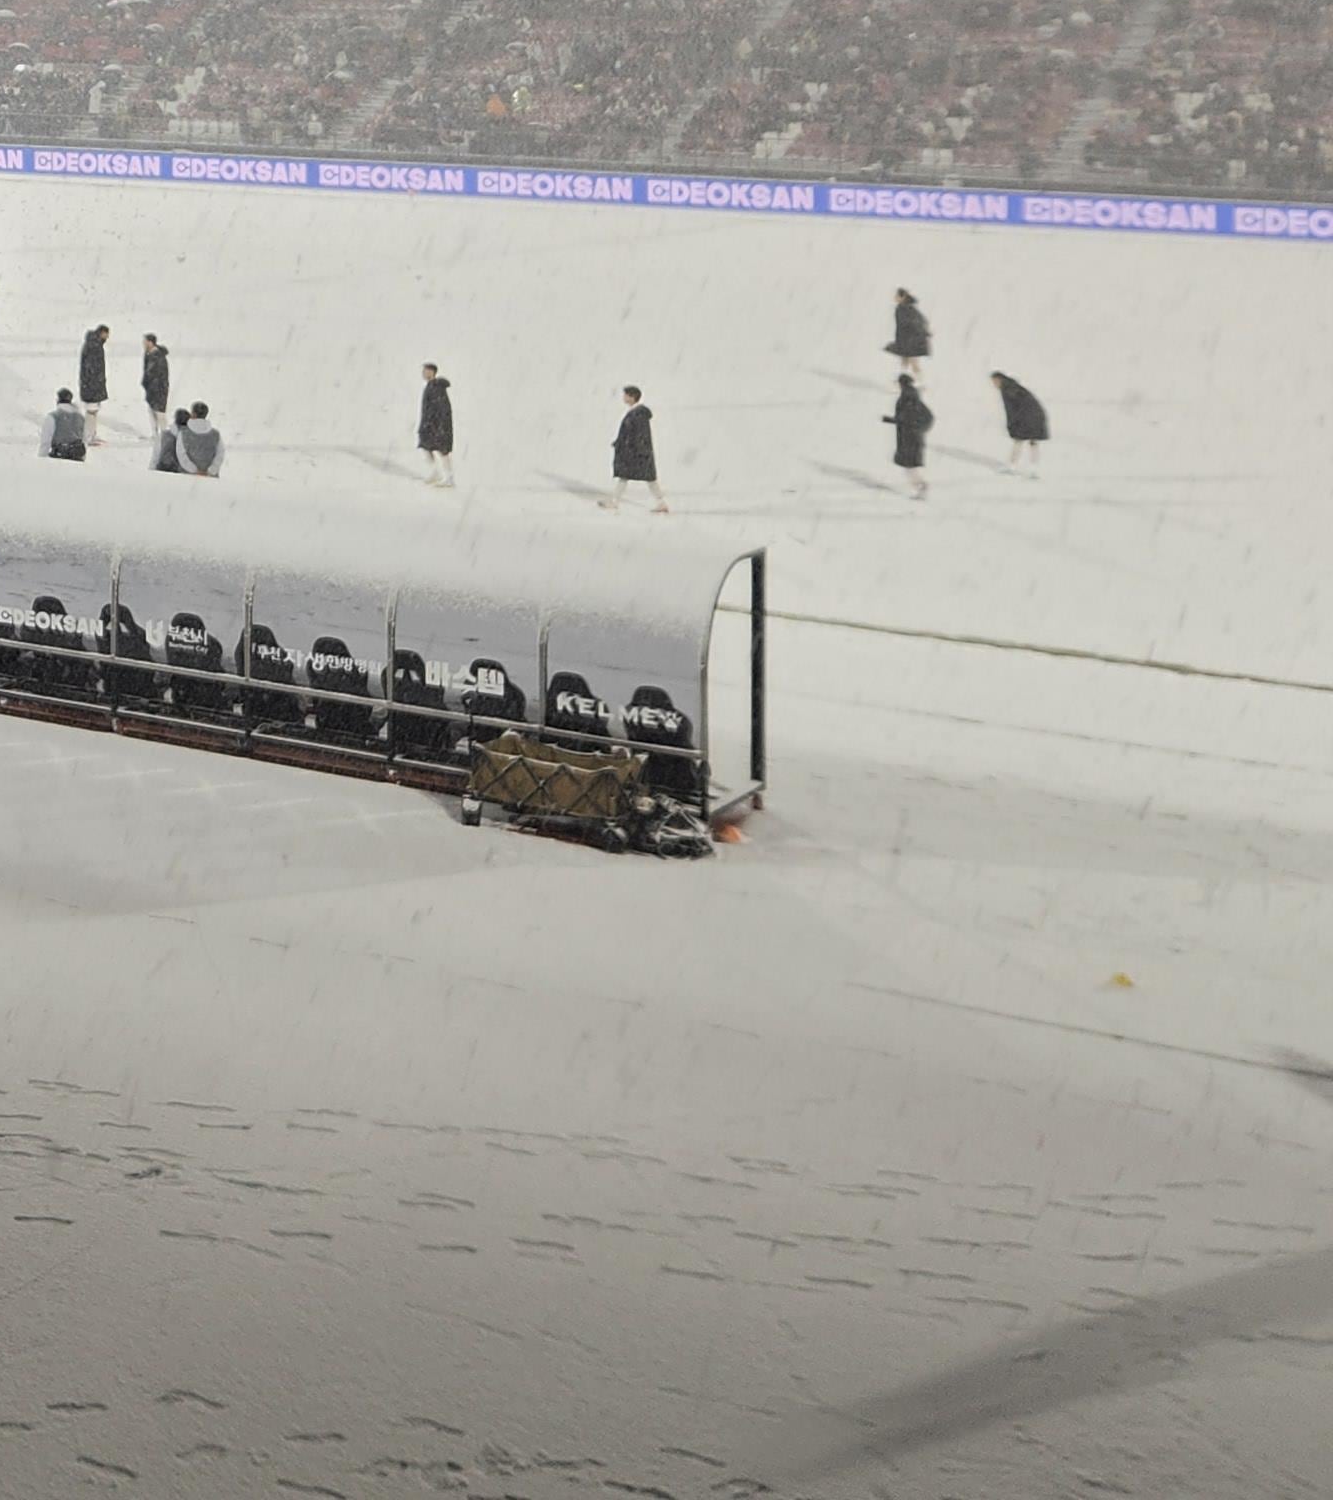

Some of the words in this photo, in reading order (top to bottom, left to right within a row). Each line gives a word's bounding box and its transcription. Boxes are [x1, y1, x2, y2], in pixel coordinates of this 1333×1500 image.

[51, 151, 160, 176] DEOKSAN
[191, 157, 307, 184] DEOKSAN
[339, 165, 464, 192] DEOKSAN
[498, 172, 633, 200] DEOKSAN
[669, 180, 814, 211] DEOKSAN
[855, 189, 1008, 220] DEOKSAN
[1052, 197, 1217, 231] DEOKSAN
[12, 608, 104, 636] DEOKSAN
[557, 691, 661, 729] KELME
